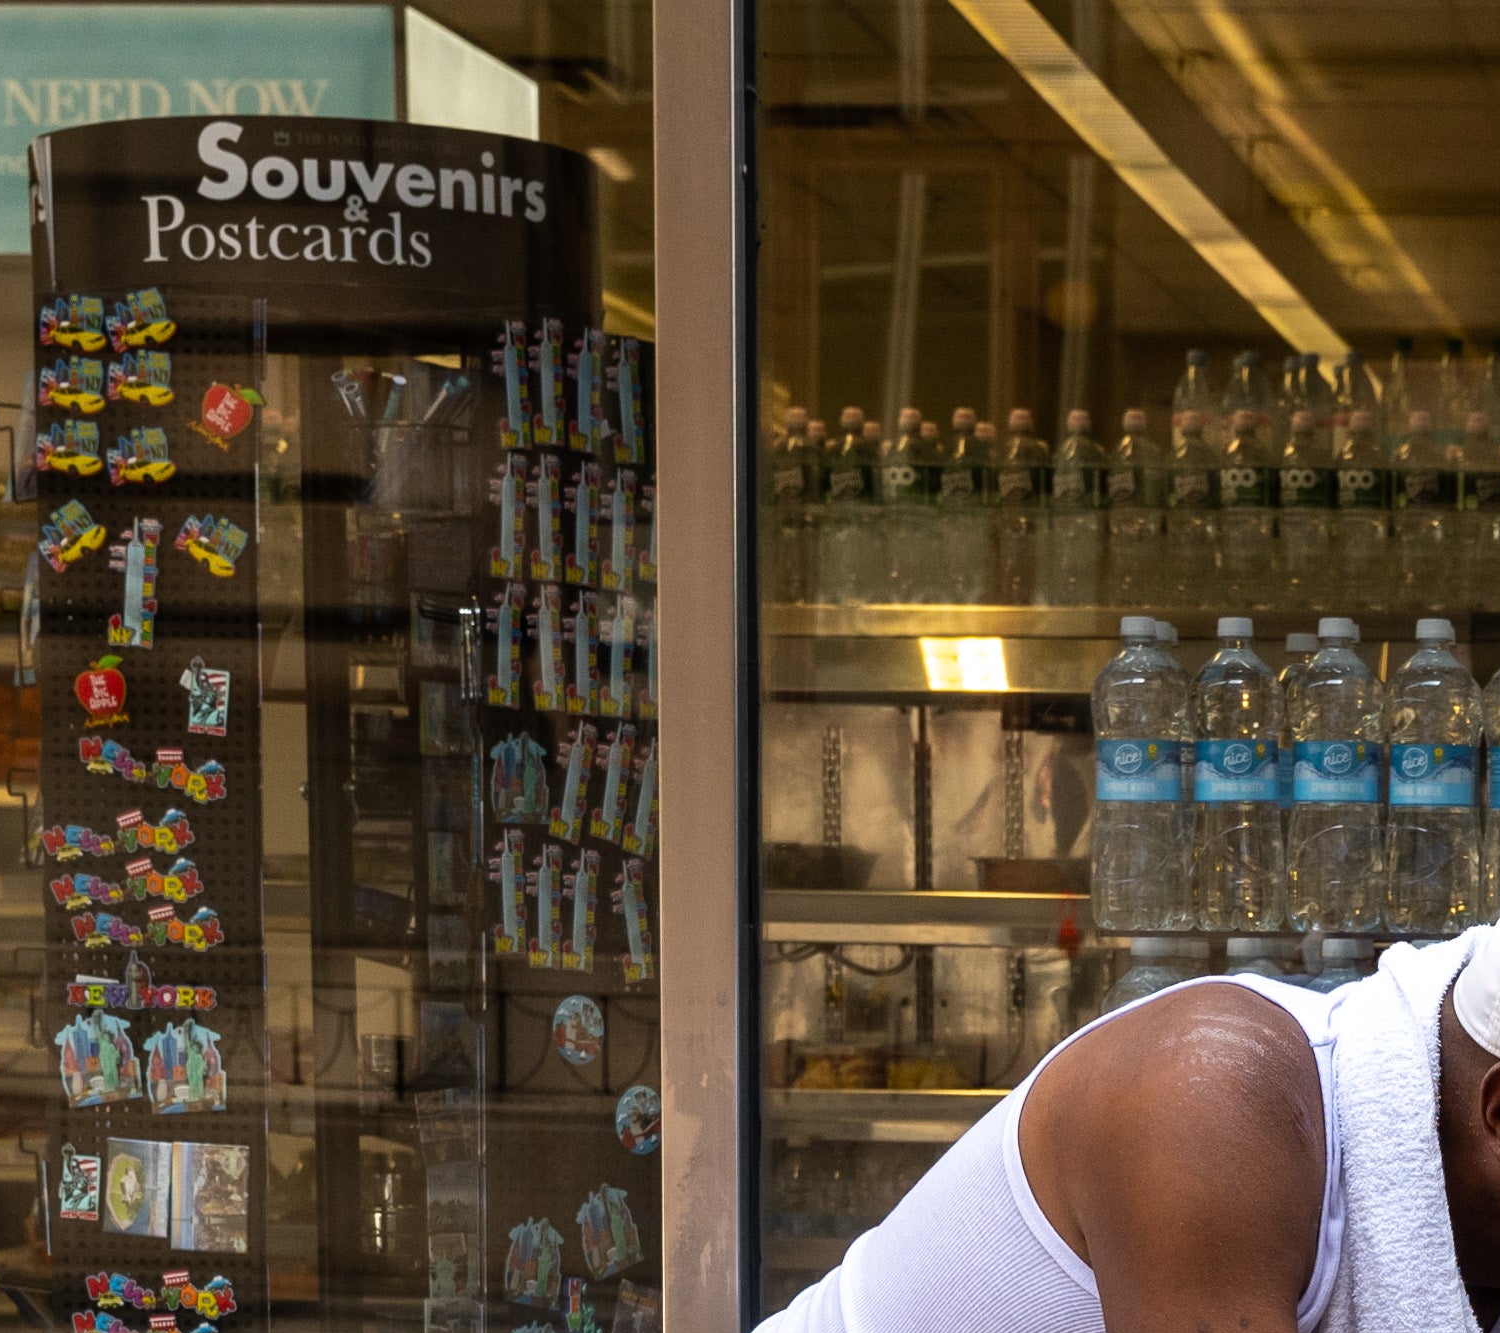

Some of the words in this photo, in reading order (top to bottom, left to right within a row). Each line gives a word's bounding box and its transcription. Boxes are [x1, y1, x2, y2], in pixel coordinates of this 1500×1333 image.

[2, 79, 172, 119] NEED
[187, 77, 331, 117] NOW
[198, 122, 546, 222] Souvenirs
[344, 196, 370, 224] &
[142, 195, 434, 268] Postcards
[79, 736, 139, 779] NEW
[155, 760, 227, 802] YORK
[41, 823, 105, 856] NEW
[118, 819, 196, 855] YORK
[50, 873, 114, 904] NEW
[128, 868, 203, 902] YORK
[71, 911, 136, 946] NEW
[148, 917, 225, 952] YORK
[67, 983, 128, 1010] NEW
[139, 985, 218, 1011] YORK
[86, 1271, 149, 1308] NEW
[162, 1284, 237, 1319] YORK
